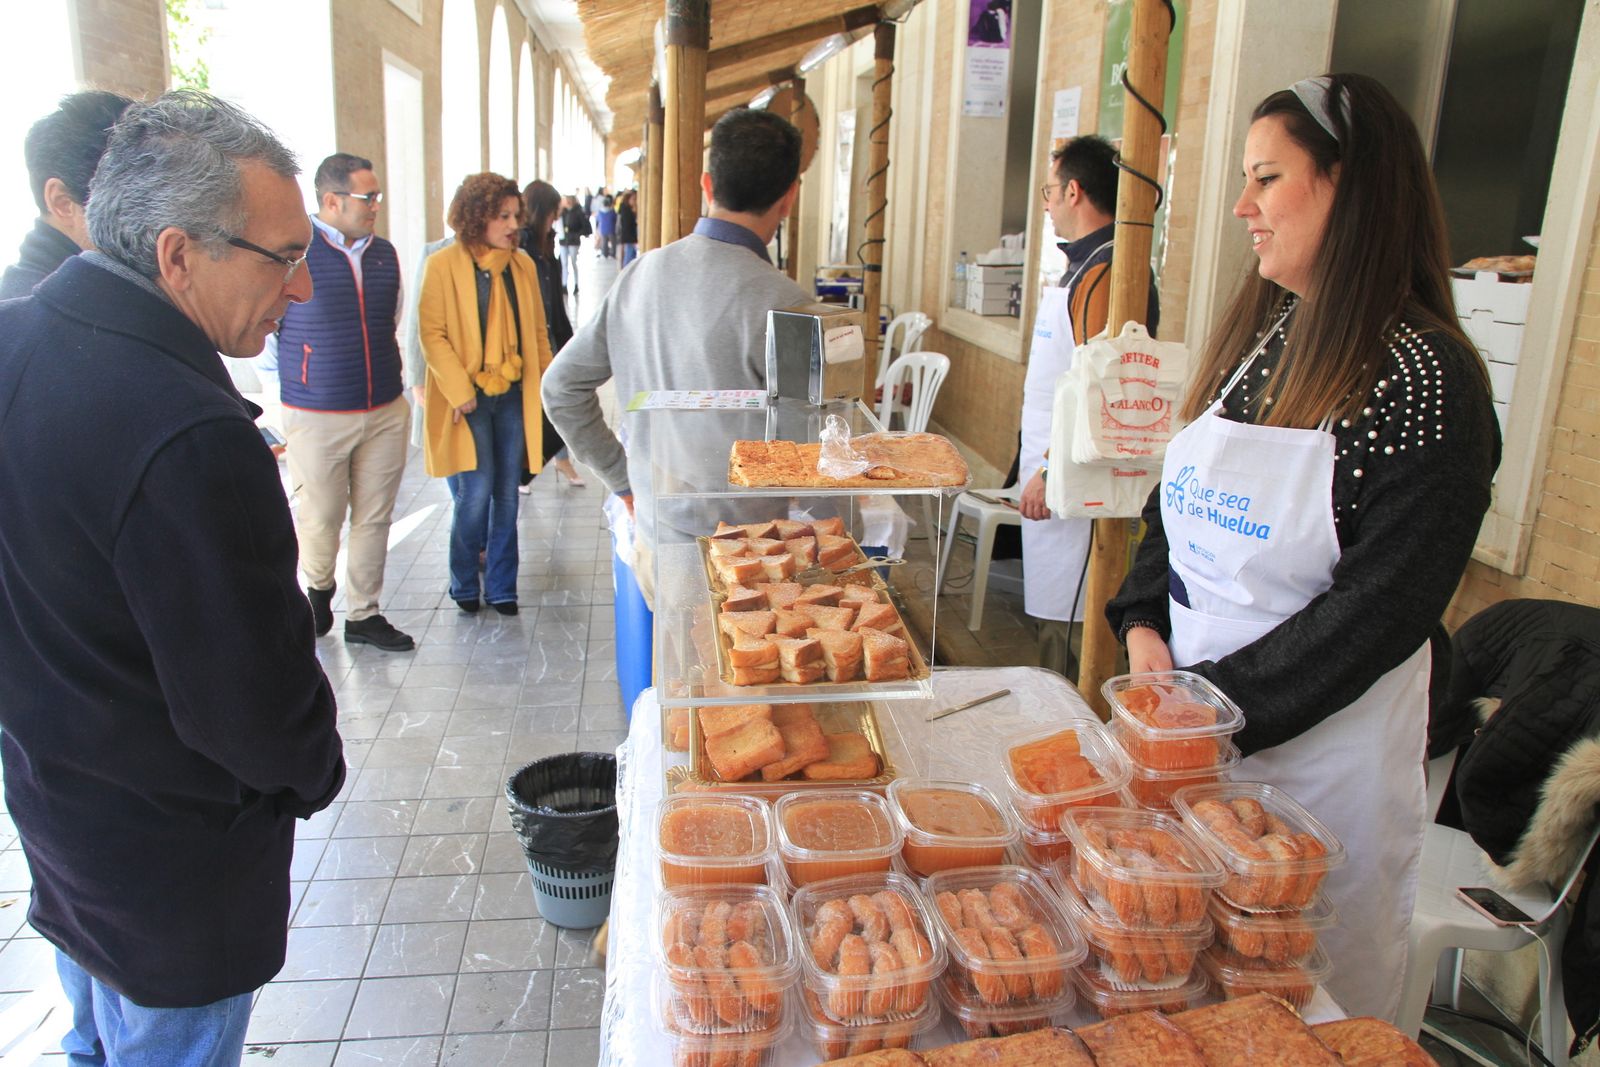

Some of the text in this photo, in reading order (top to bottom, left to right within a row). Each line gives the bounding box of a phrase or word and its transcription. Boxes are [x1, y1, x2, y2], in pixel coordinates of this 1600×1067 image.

[1189, 478, 1252, 512] Que sea
[1187, 501, 1271, 540] de Huelva
